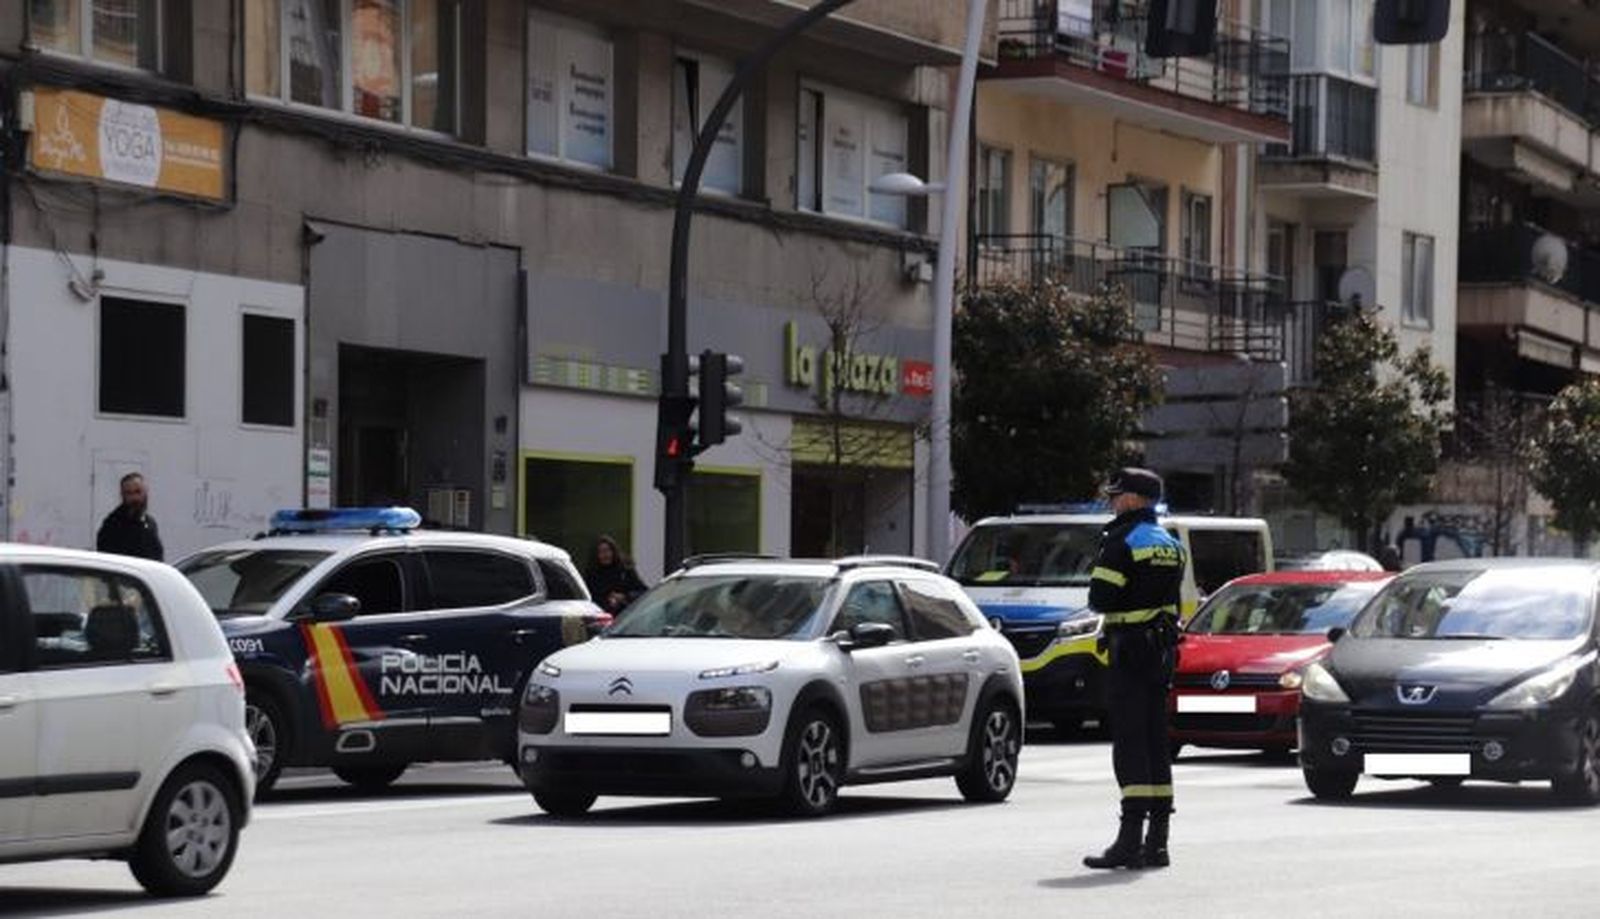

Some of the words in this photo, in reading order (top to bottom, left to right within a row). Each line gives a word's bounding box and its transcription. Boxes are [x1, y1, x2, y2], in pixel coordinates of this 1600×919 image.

[104, 125, 155, 159] YOGA
[784, 319, 814, 387] la
[818, 339, 898, 411] plaza
[380, 674, 513, 696] NACIONAL
